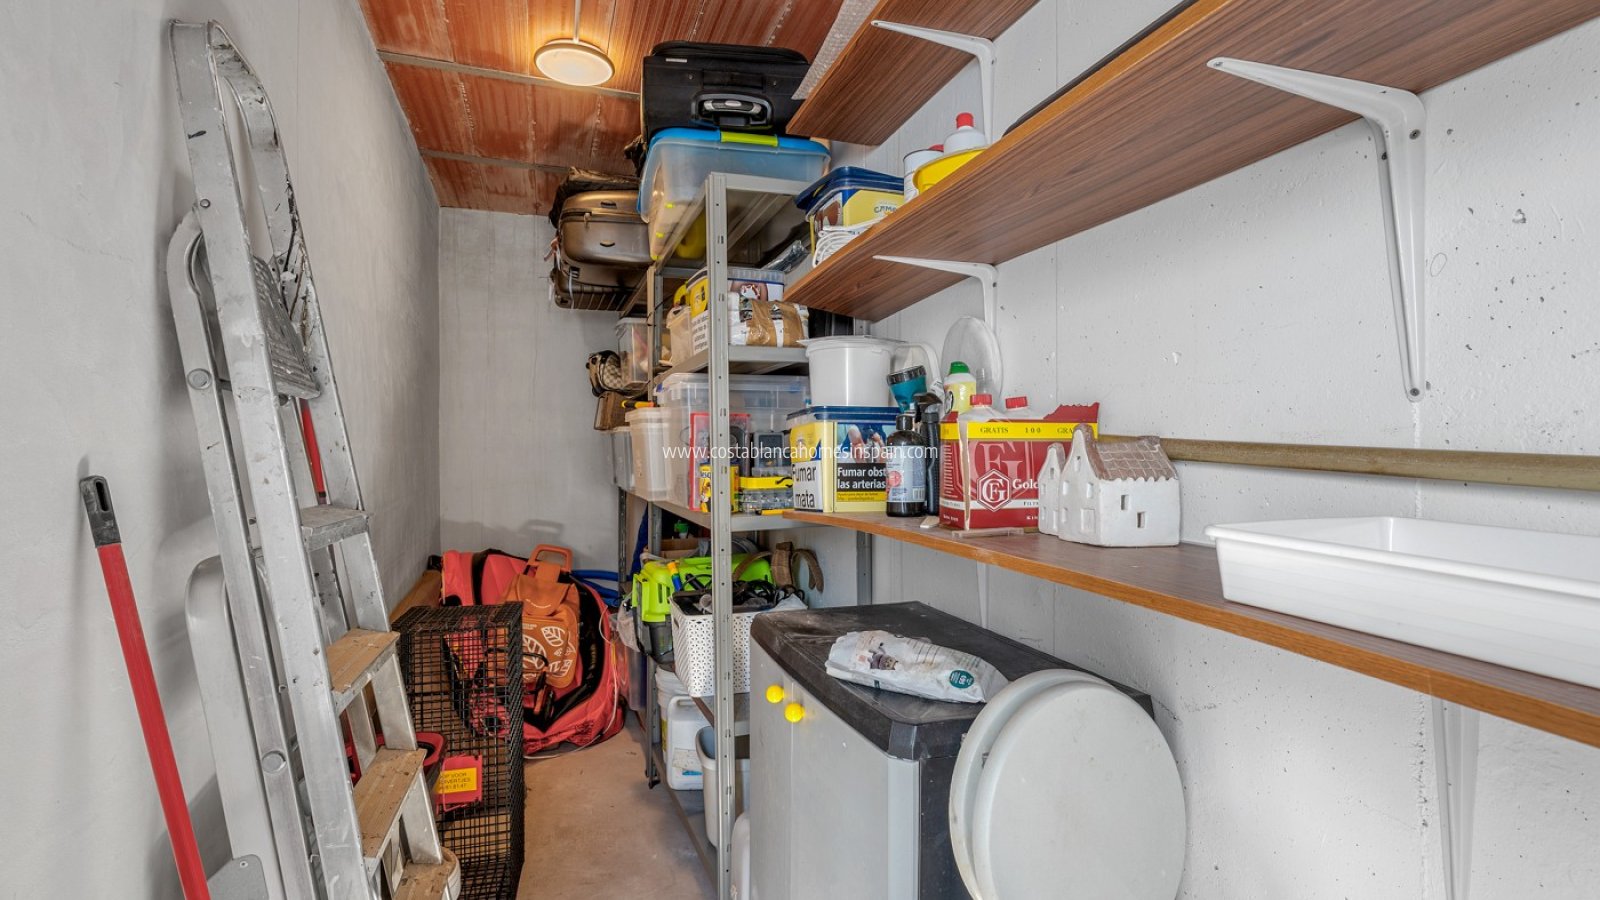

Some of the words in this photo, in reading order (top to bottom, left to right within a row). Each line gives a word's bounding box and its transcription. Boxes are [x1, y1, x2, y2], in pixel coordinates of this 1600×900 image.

[980, 426, 1009, 434] GRATIS
[792, 464, 817, 481] Fumar
[837, 466, 865, 477] Fumar
[868, 466, 886, 477] obst
[837, 480, 850, 489] las
[852, 480, 886, 489] arterias
[795, 489, 815, 508] mata
